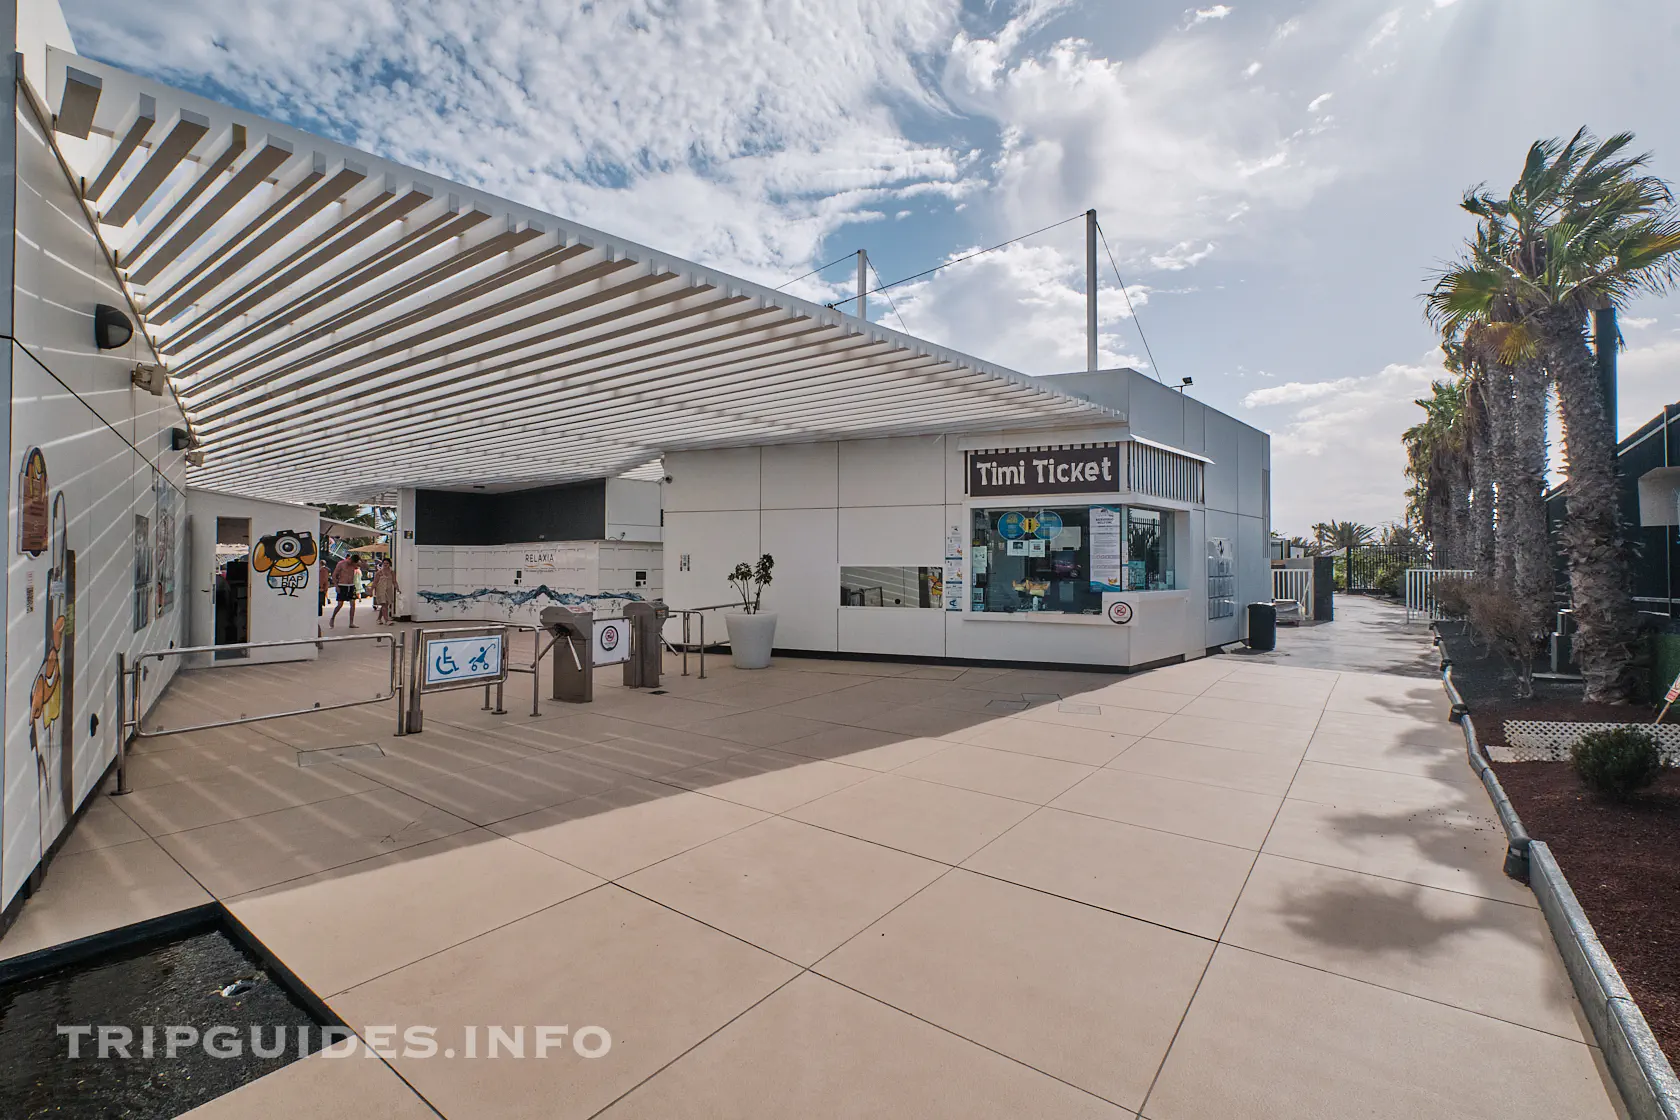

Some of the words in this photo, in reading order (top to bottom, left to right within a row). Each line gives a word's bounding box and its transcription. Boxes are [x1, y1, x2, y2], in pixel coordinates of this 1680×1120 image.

[976, 460, 1026, 485] Timi
[1033, 457, 1112, 484] Ticket
[525, 553, 554, 563] RELAXIA
